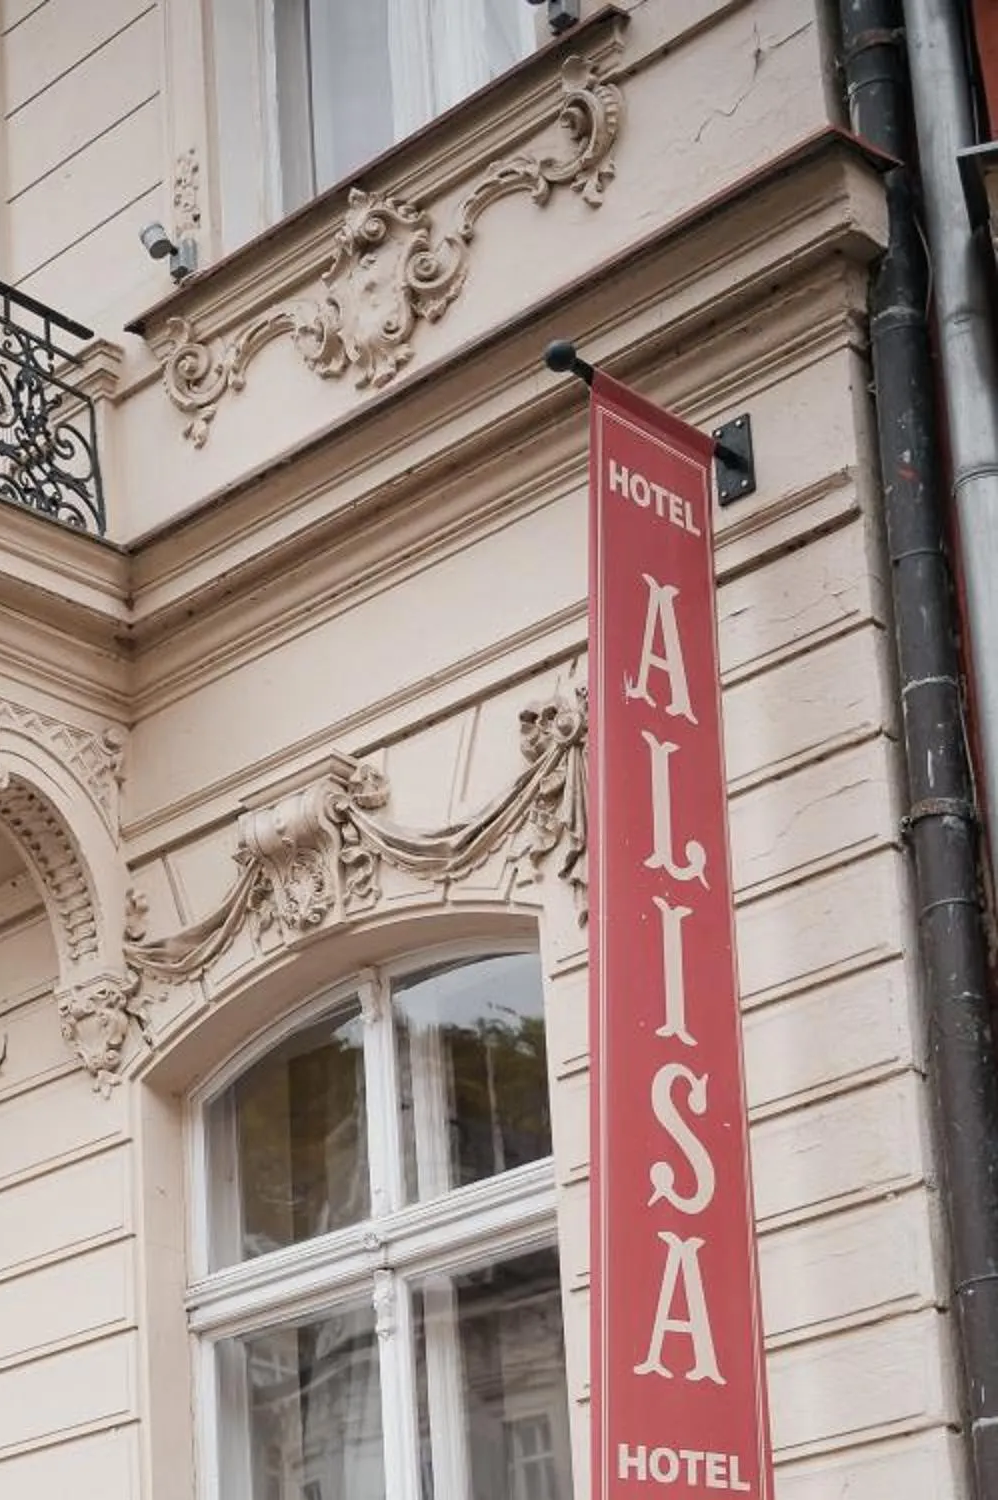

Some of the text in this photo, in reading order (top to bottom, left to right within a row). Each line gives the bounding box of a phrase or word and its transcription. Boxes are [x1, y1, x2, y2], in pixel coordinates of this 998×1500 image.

[608, 459, 701, 538] HOTEL
[622, 572, 727, 1385] ALISA
[617, 1443, 751, 1492] HOTEL
